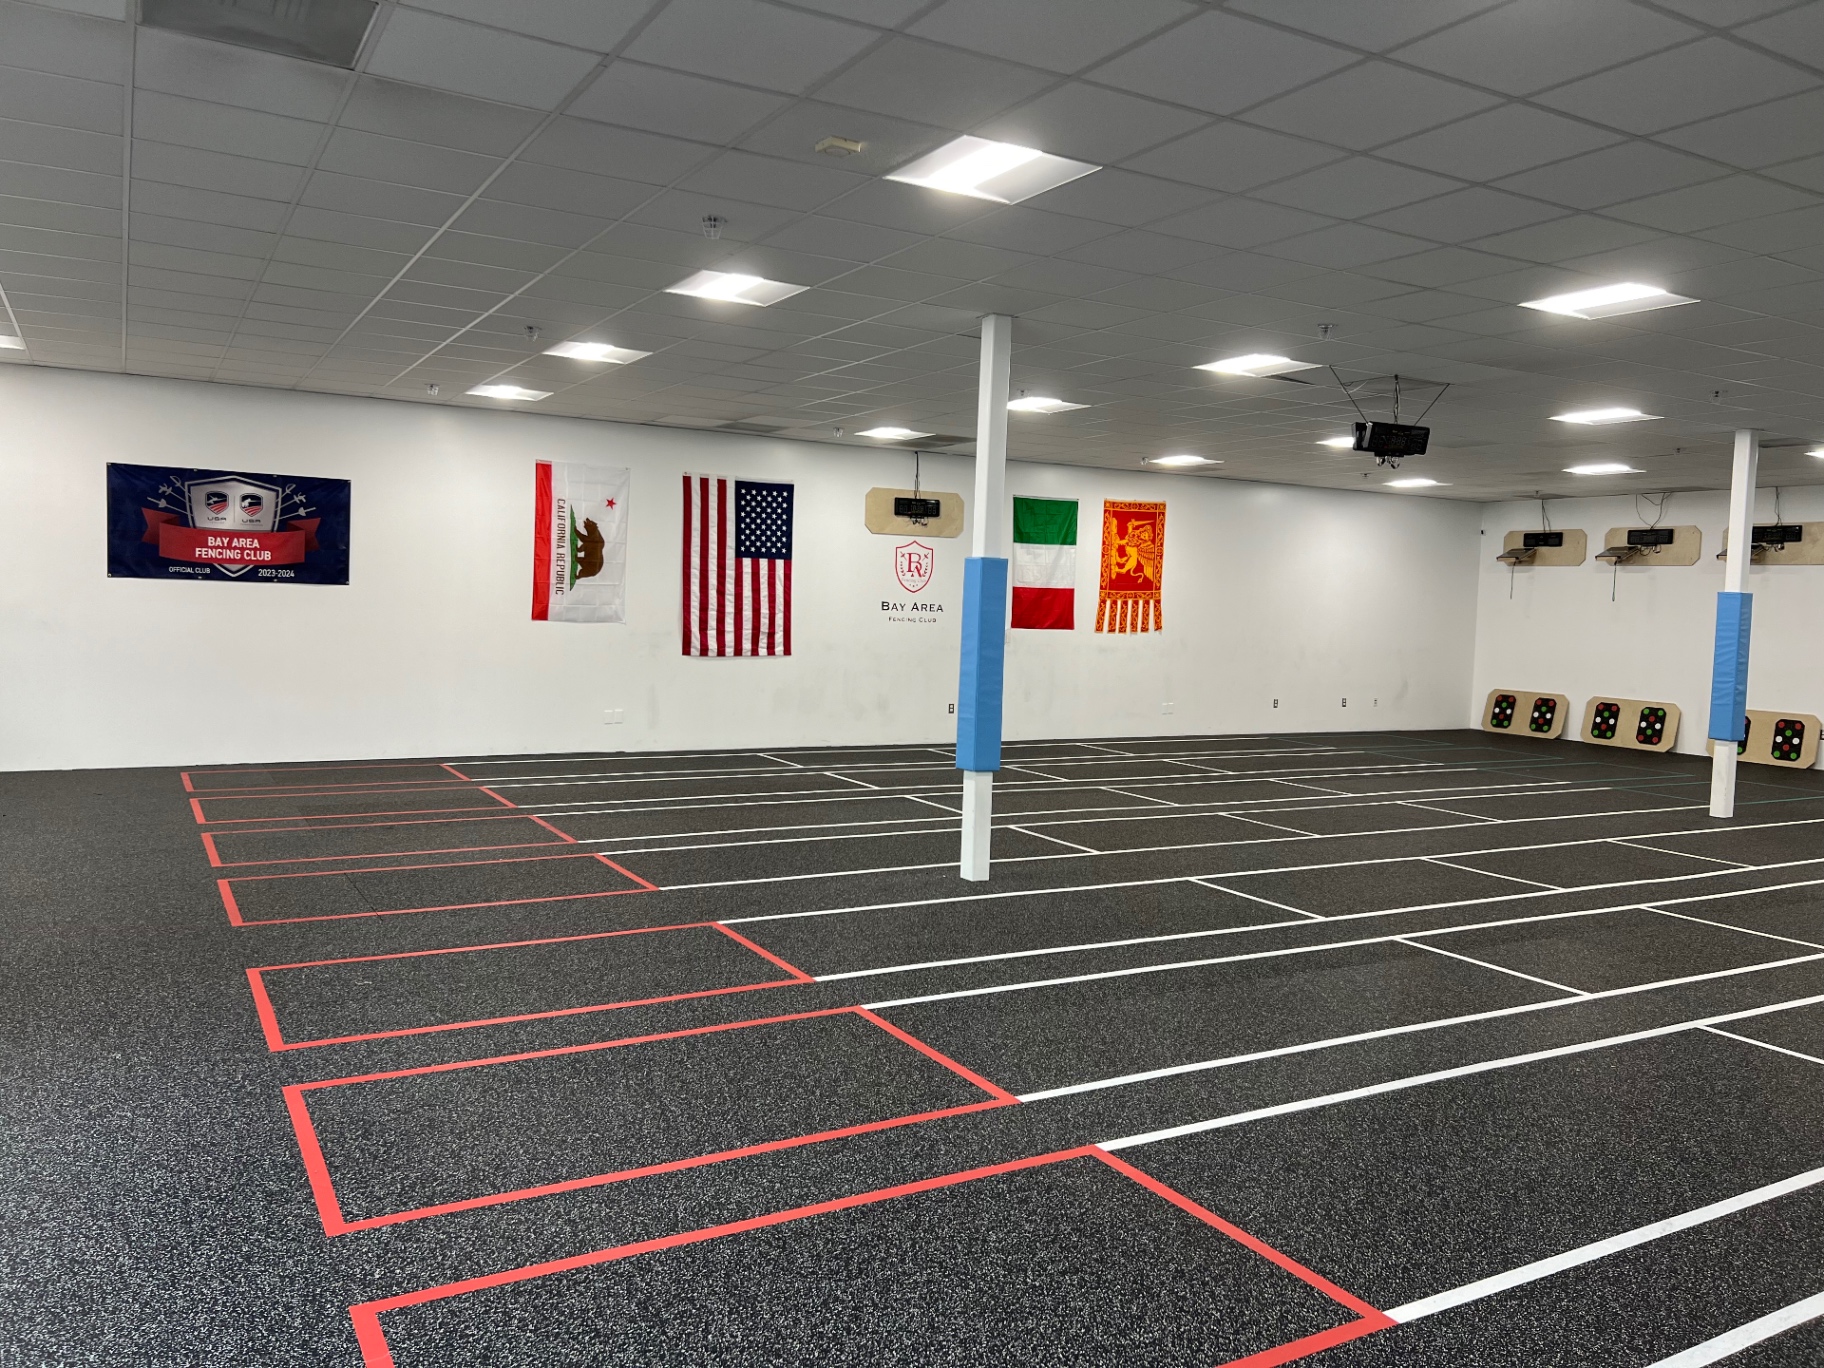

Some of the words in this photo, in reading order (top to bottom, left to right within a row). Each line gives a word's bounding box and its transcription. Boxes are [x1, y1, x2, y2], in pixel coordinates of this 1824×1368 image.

[556, 498, 566, 549] CALIFORNIA
[207, 536, 230, 547] BAY
[231, 538, 260, 548] AREA
[195, 547, 241, 559] FENCING
[244, 550, 272, 561] CLUB
[258, 568, 295, 577] 2023-2024
[555, 553, 566, 595] REPUBLIC
